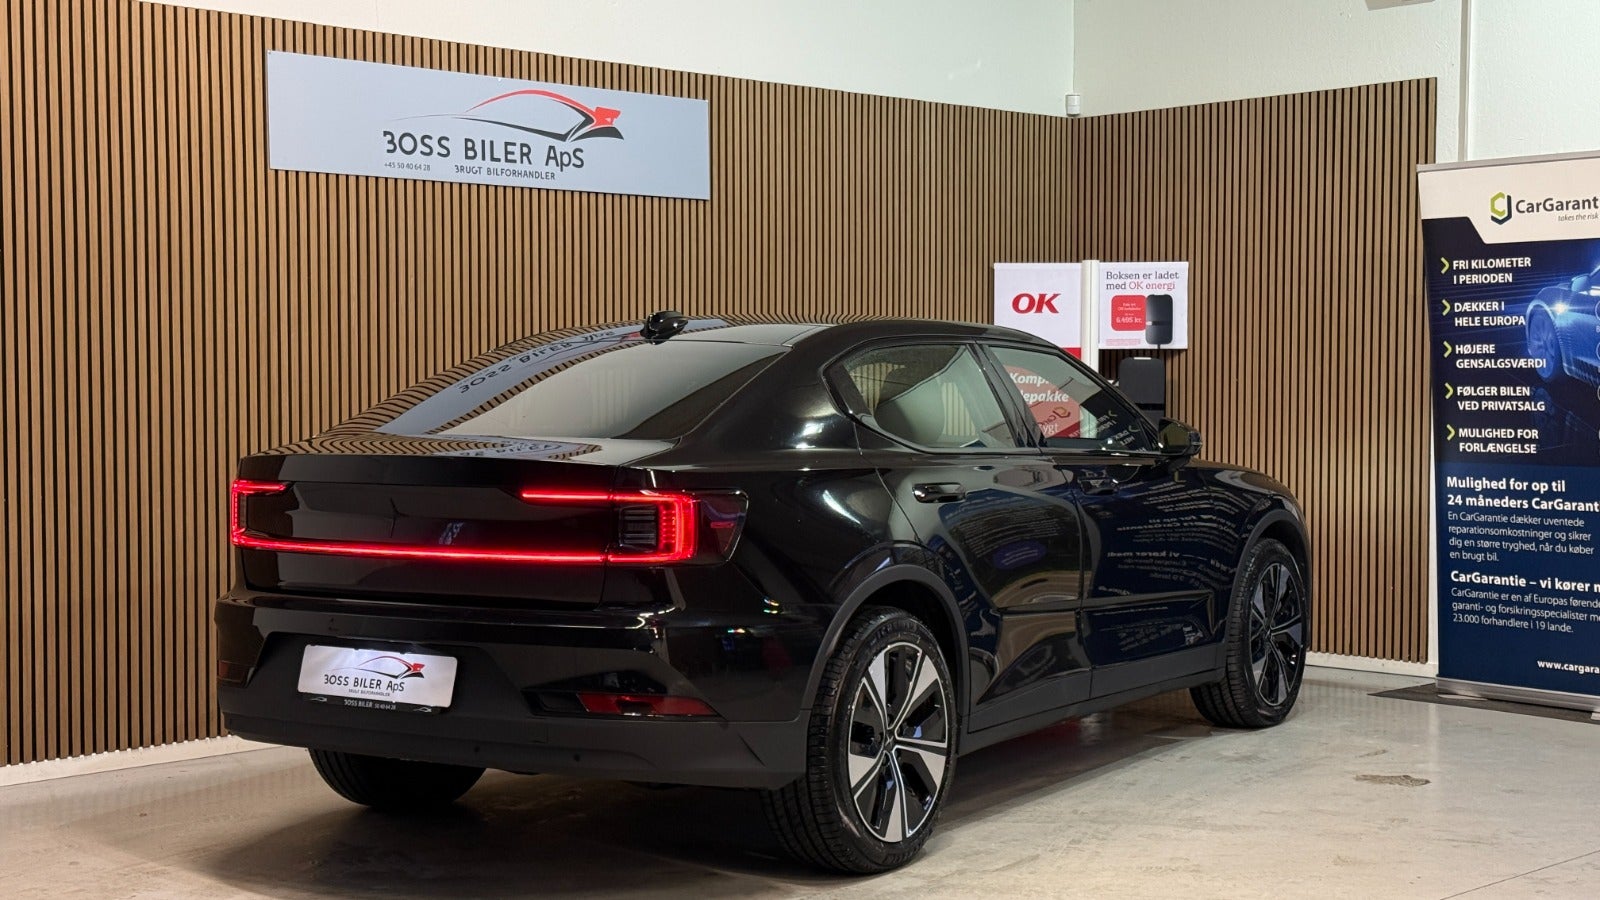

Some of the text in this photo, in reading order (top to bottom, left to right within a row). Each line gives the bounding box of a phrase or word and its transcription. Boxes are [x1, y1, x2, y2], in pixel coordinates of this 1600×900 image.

[383, 131, 584, 172] BOSS BILER ApS
[454, 164, 556, 180] BRUGT BILFORHANDLER
[1516, 196, 1599, 214] CarGarant
[1588, 212, 1599, 220] risk
[1452, 257, 1532, 270] FRI KILOMETER
[1106, 271, 1140, 280] Boksen
[1155, 271, 1179, 280] ladet
[1453, 273, 1512, 284] I PERIODEN
[1106, 281, 1176, 291] med OK energi
[1012, 292, 1061, 314] OK
[1454, 301, 1504, 312] DÆKKER I
[1454, 316, 1526, 326] HELE EUROPA
[1455, 344, 1496, 354] HØJERE
[1456, 358, 1546, 368] GENSALGSVÆRDI
[1456, 386, 1530, 396] FØLGER BILEN
[1458, 401, 1546, 412] VED PRIVATSALG
[1458, 428, 1538, 439] MULIGHED FOR
[1459, 442, 1537, 454] FORLÆNGELSE
[1446, 476, 1566, 494] Mulighed for op til
[1448, 494, 1462, 506] 24
[1466, 494, 1528, 508] måneders
[1448, 511, 1584, 527] En CarGarantie dækker uventede
[1448, 525, 1592, 542] reparationsomkostninger og sikrer
[1449, 537, 1594, 554] dig en større tryghed, når du køber
[1462, 551, 1485, 562] brugt
[1486, 552, 1499, 562] bil.
[1450, 570, 1526, 587] CarGarantie
[1540, 578, 1552, 589] vi
[1554, 578, 1590, 592] kører
[1451, 588, 1500, 600] CarGarantie
[1510, 594, 1522, 602] en
[1524, 593, 1532, 602] af
[1534, 594, 1568, 606] Europas
[1452, 602, 1484, 611] garanti-
[1485, 605, 1496, 614] og
[1498, 604, 1587, 620] forsikringsspecialister
[1452, 613, 1480, 624] 23.000
[1481, 616, 1528, 629] forhandlere
[1536, 621, 1546, 630] 19
[1548, 622, 1574, 632] lande.
[324, 674, 405, 693] BOSS BILER ApS
